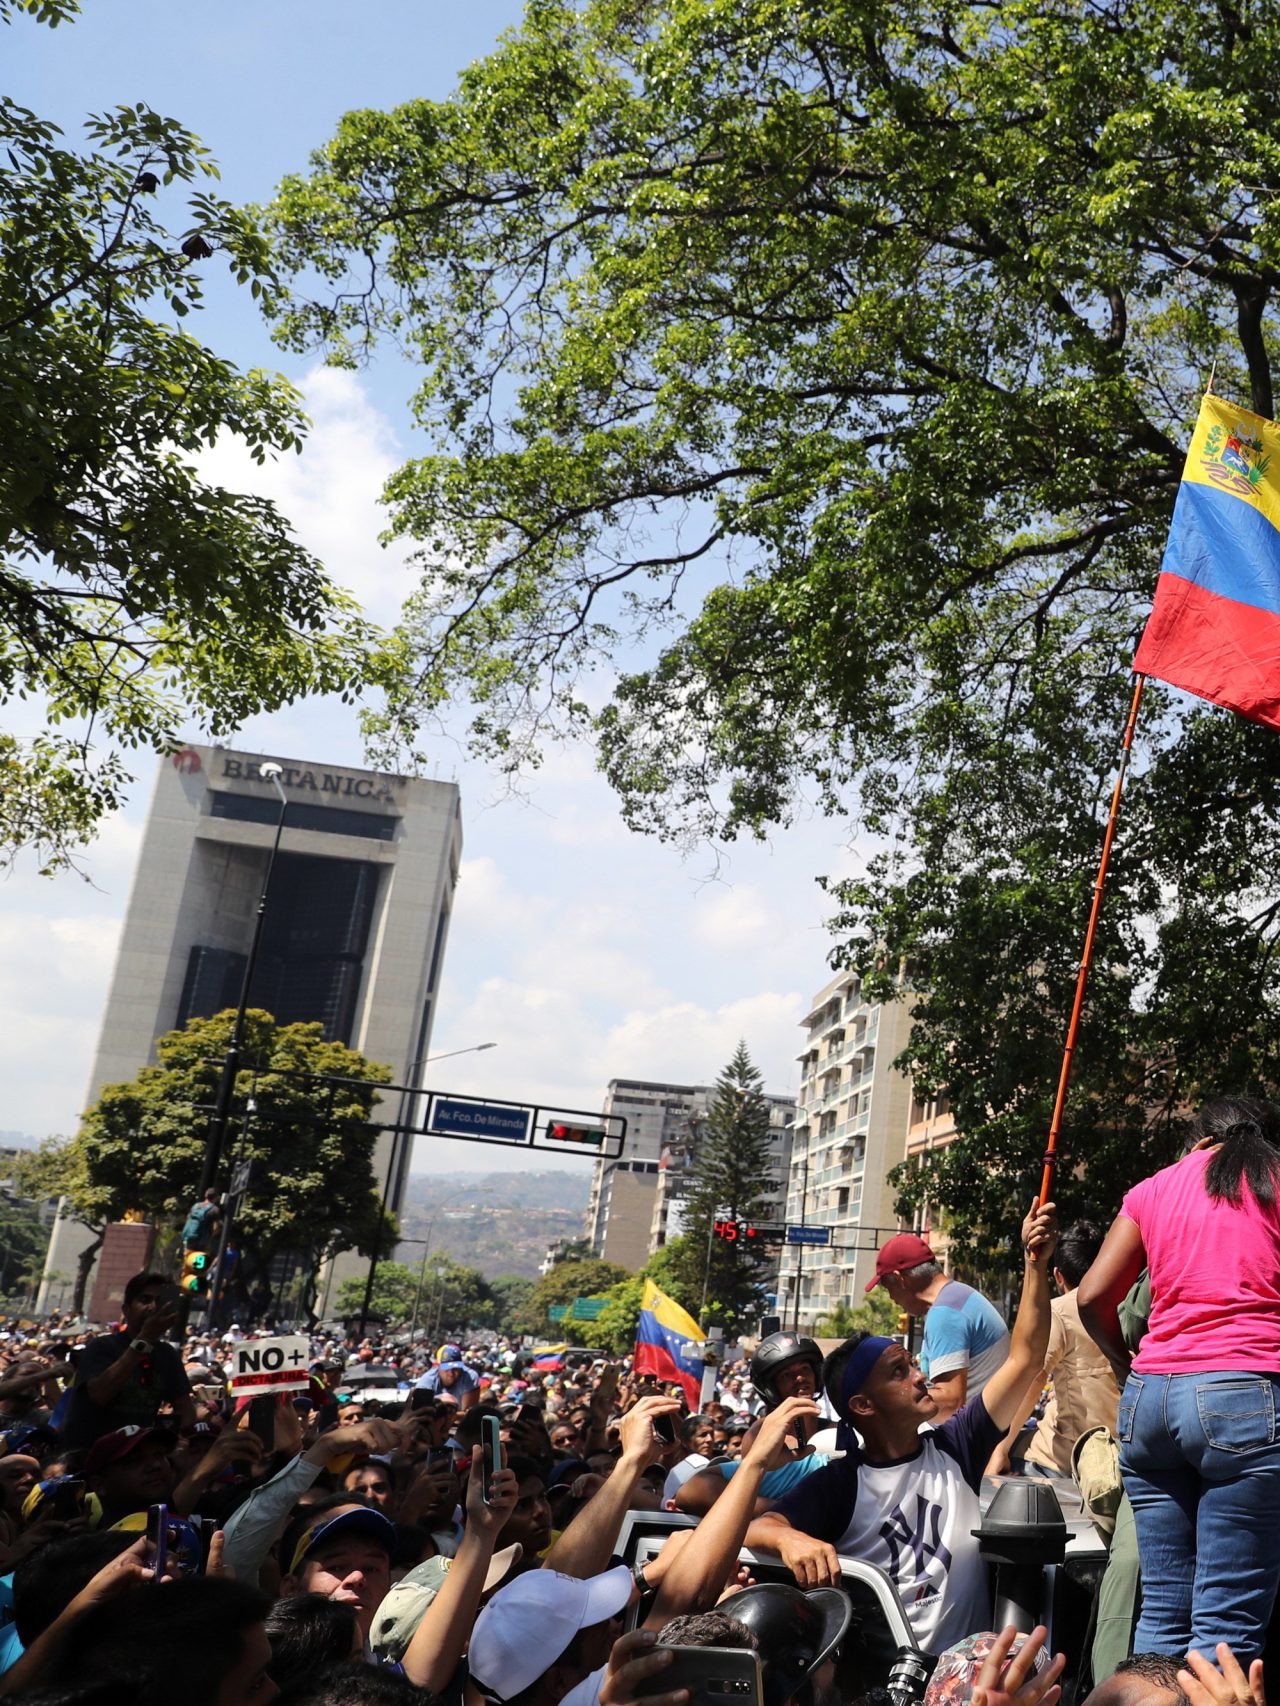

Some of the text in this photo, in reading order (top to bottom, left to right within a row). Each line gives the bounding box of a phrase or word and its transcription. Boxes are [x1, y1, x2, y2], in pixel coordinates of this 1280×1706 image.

[222, 758, 394, 801] BRTANICA
[438, 1109, 525, 1128] Av. Fco. De Miranda
[713, 1221, 737, 1240] 45
[239, 1370, 303, 1386] DICTADURA
[914, 1595, 943, 1609] Majestic
